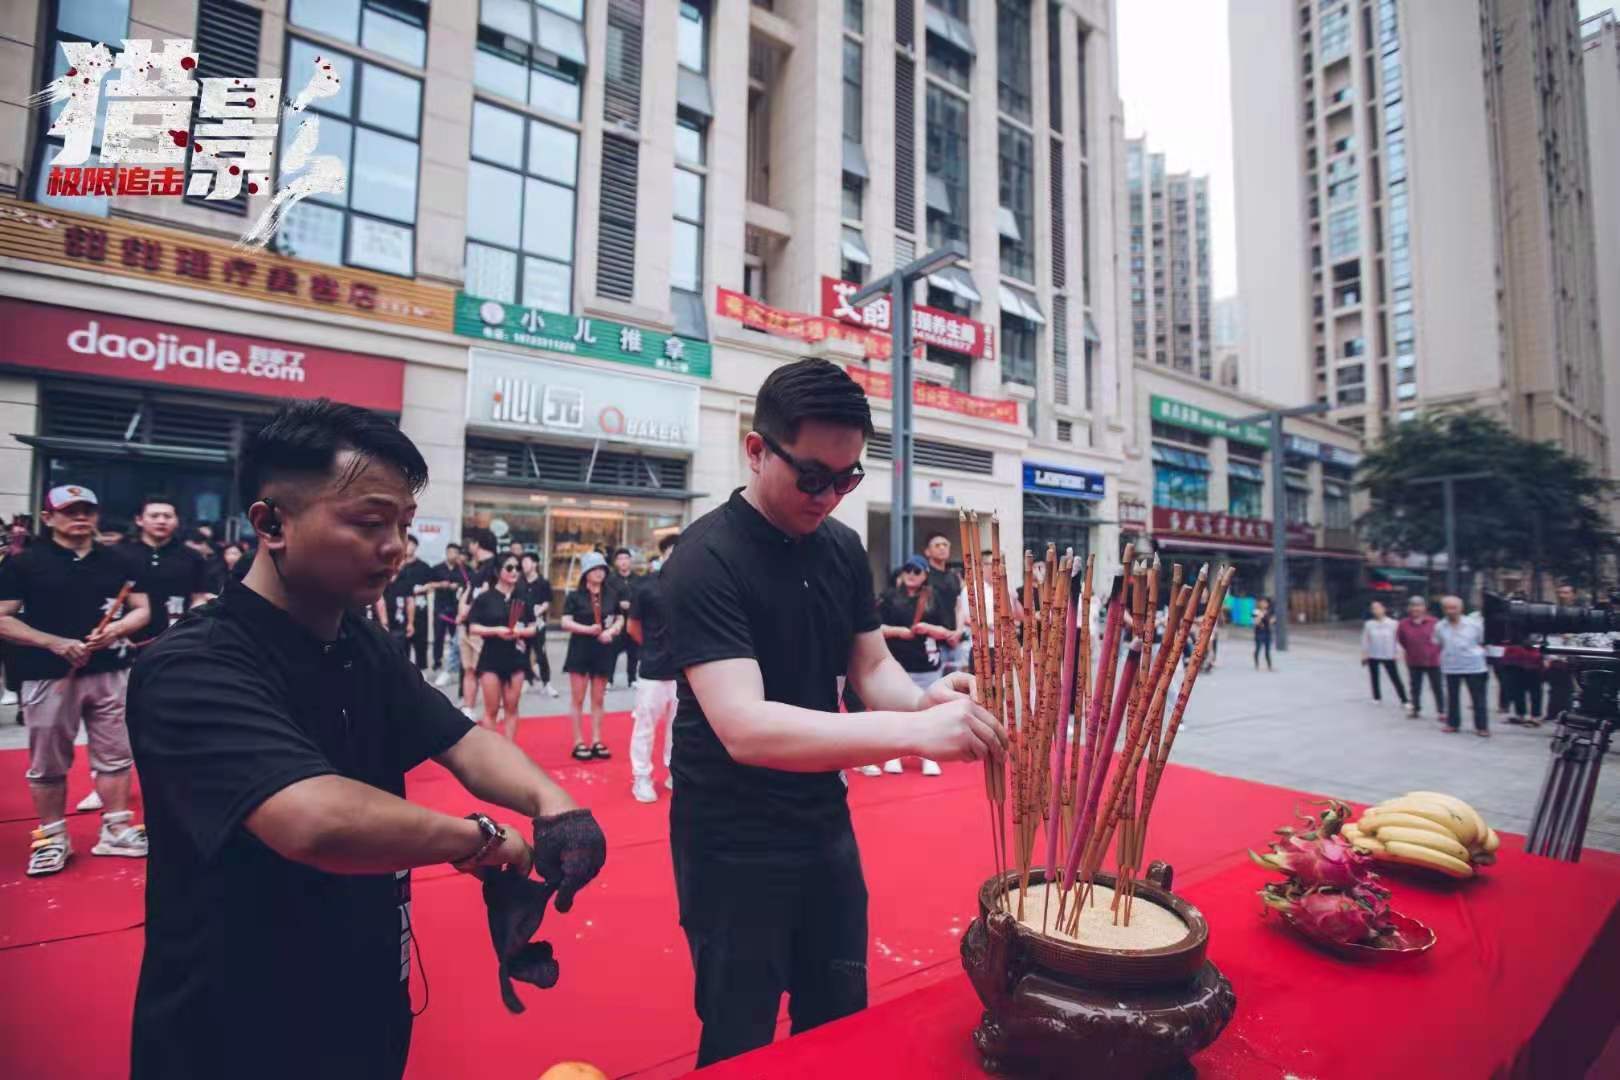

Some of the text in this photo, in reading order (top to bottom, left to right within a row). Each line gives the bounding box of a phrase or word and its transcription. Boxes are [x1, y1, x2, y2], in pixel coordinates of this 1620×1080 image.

[67, 321, 305, 382] daojiale.com
[520, 310, 685, 360] 小儿推拿
